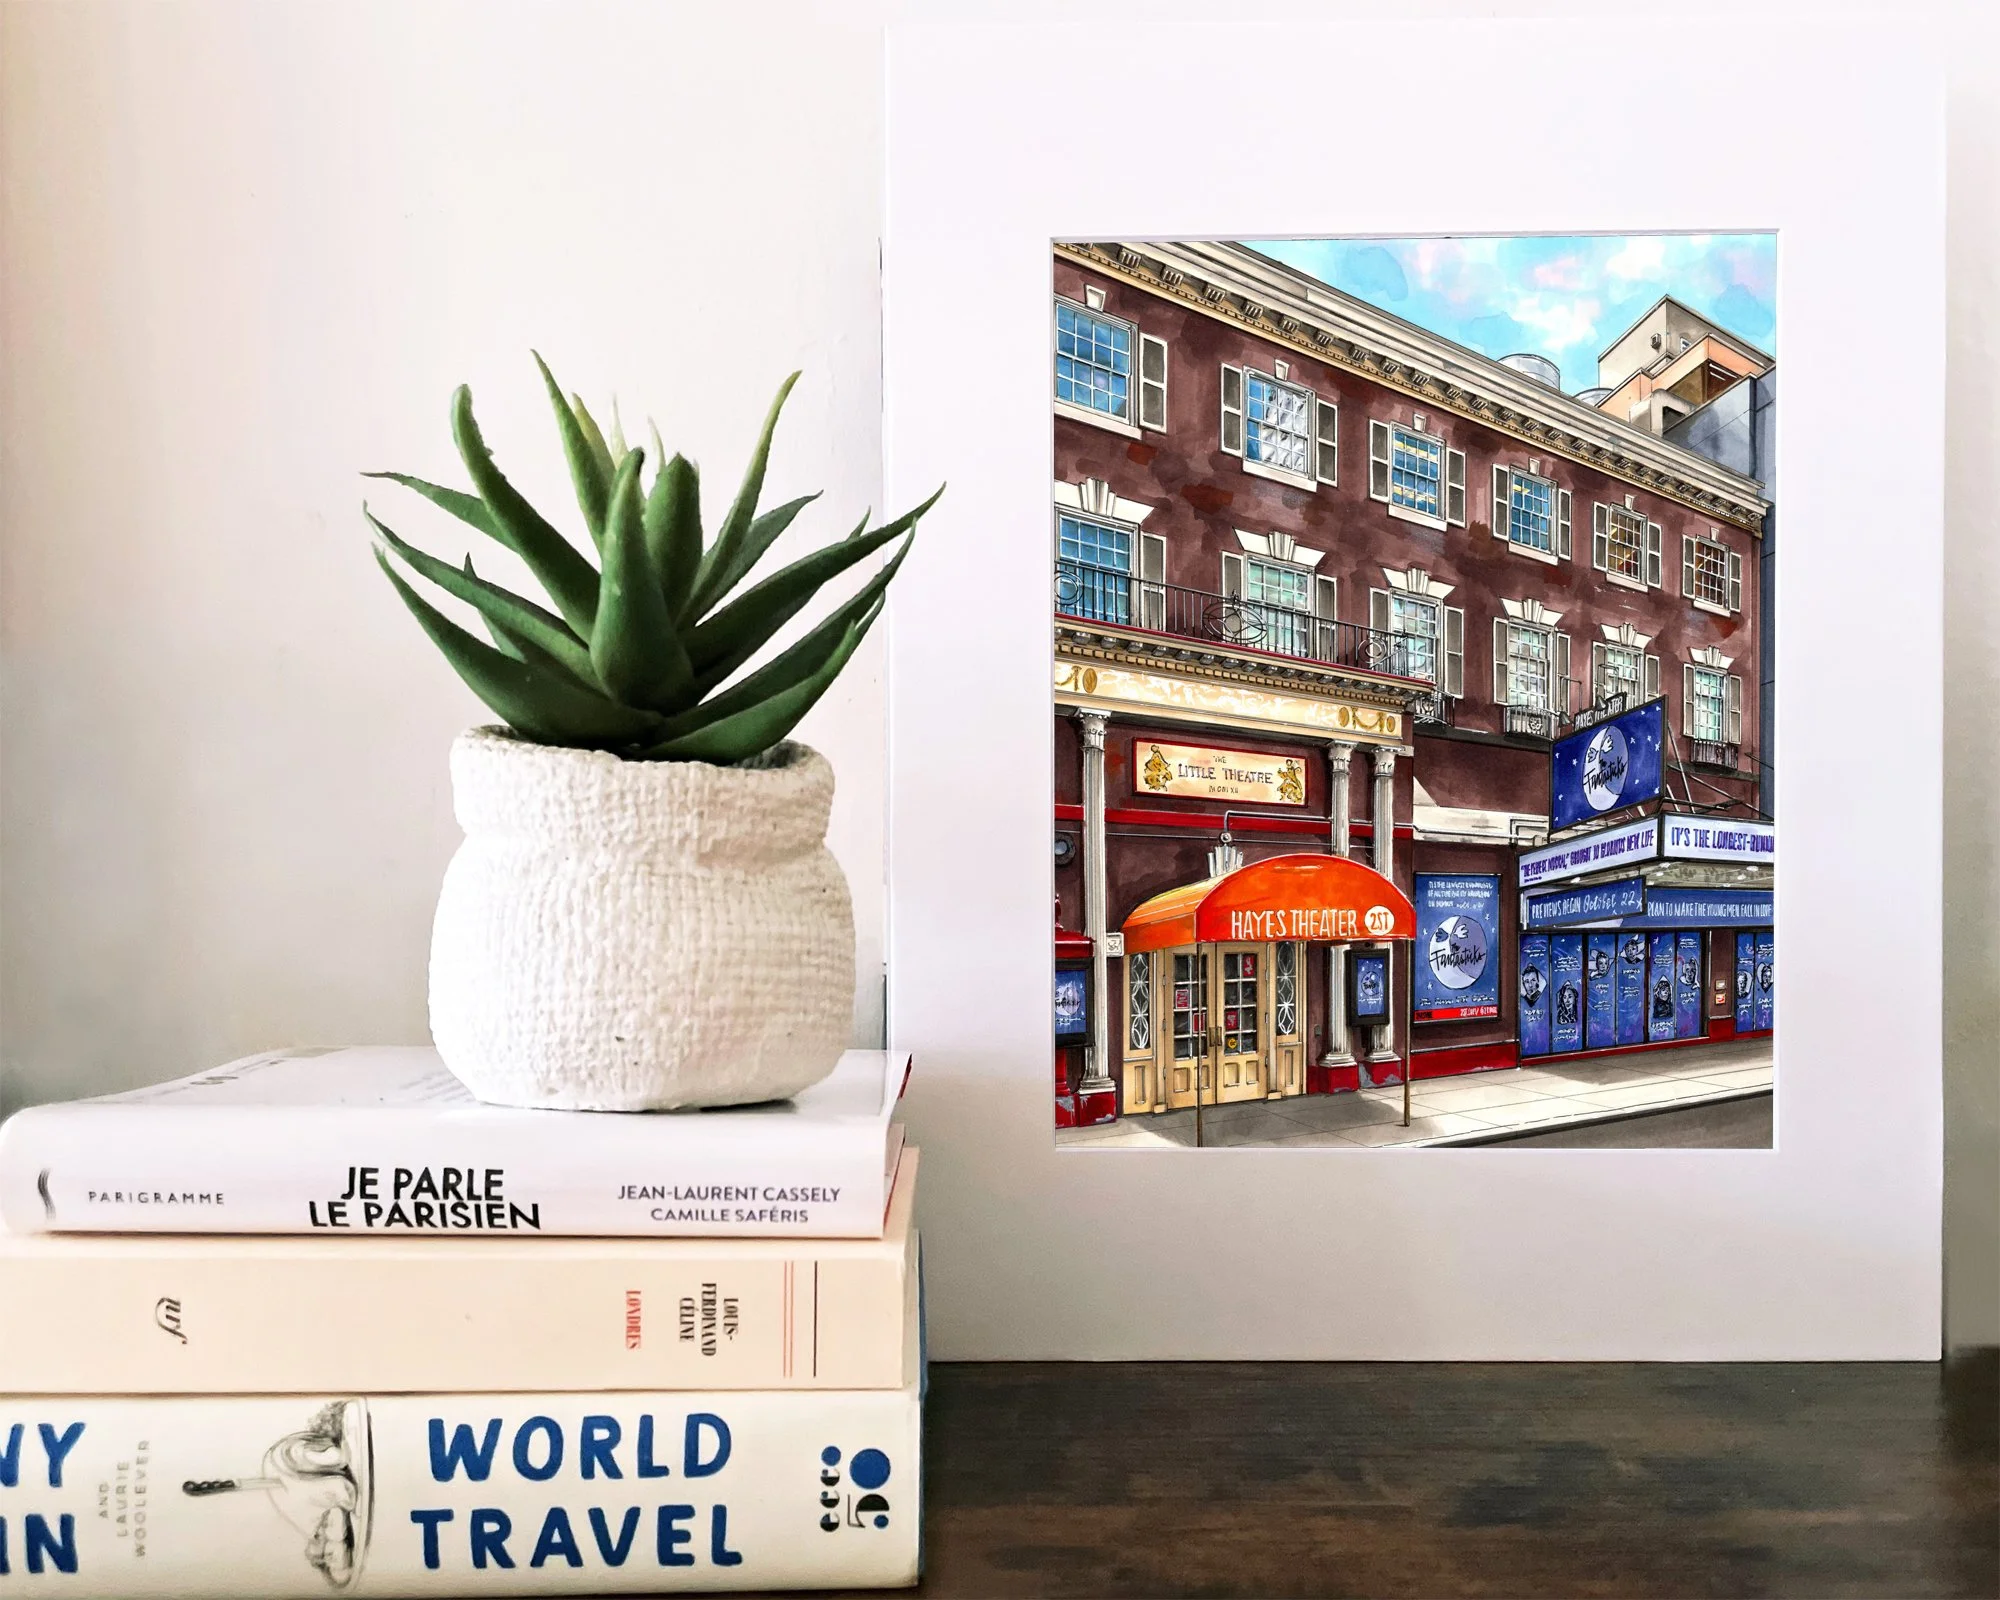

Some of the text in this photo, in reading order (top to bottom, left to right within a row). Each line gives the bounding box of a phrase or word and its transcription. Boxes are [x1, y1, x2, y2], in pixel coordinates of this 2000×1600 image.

[1178, 763, 1274, 784] LITTLE THEATRE
[1641, 829, 1654, 848] LIFE
[1671, 826, 1691, 847] IT'S
[1693, 828, 1711, 849] THE
[1231, 909, 1287, 940] HAYES
[1289, 908, 1361, 938] THEATER
[1647, 902, 1665, 917] PLAN
[1665, 902, 1673, 917] TO
[1674, 902, 1694, 917] MAKE
[1694, 902, 1706, 917] THE
[1726, 904, 1740, 917] MEN
[1741, 904, 1753, 917] FALL
[1754, 904, 1760, 917] IN
[88, 1191, 225, 1205] PARIGRAMME
[340, 1167, 504, 1201] JE PARLE
[618, 1185, 841, 1203] JEAN-LAURENT CASSELY
[309, 1201, 541, 1229] LE PARISIEN
[651, 1206, 809, 1223] CAMILLE SAFÉRIS
[626, 1290, 641, 1350] LONDRES
[701, 1283, 717, 1356] FERDINAND
[723, 1298, 739, 1341] LOUIS-
[428, 1412, 732, 1482] WORLD
[99, 1482, 110, 1519] AND
[116, 1461, 130, 1538] LAURIE
[134, 1440, 149, 1558] WOOLEVER
[411, 1504, 743, 1570] TRAVEL
